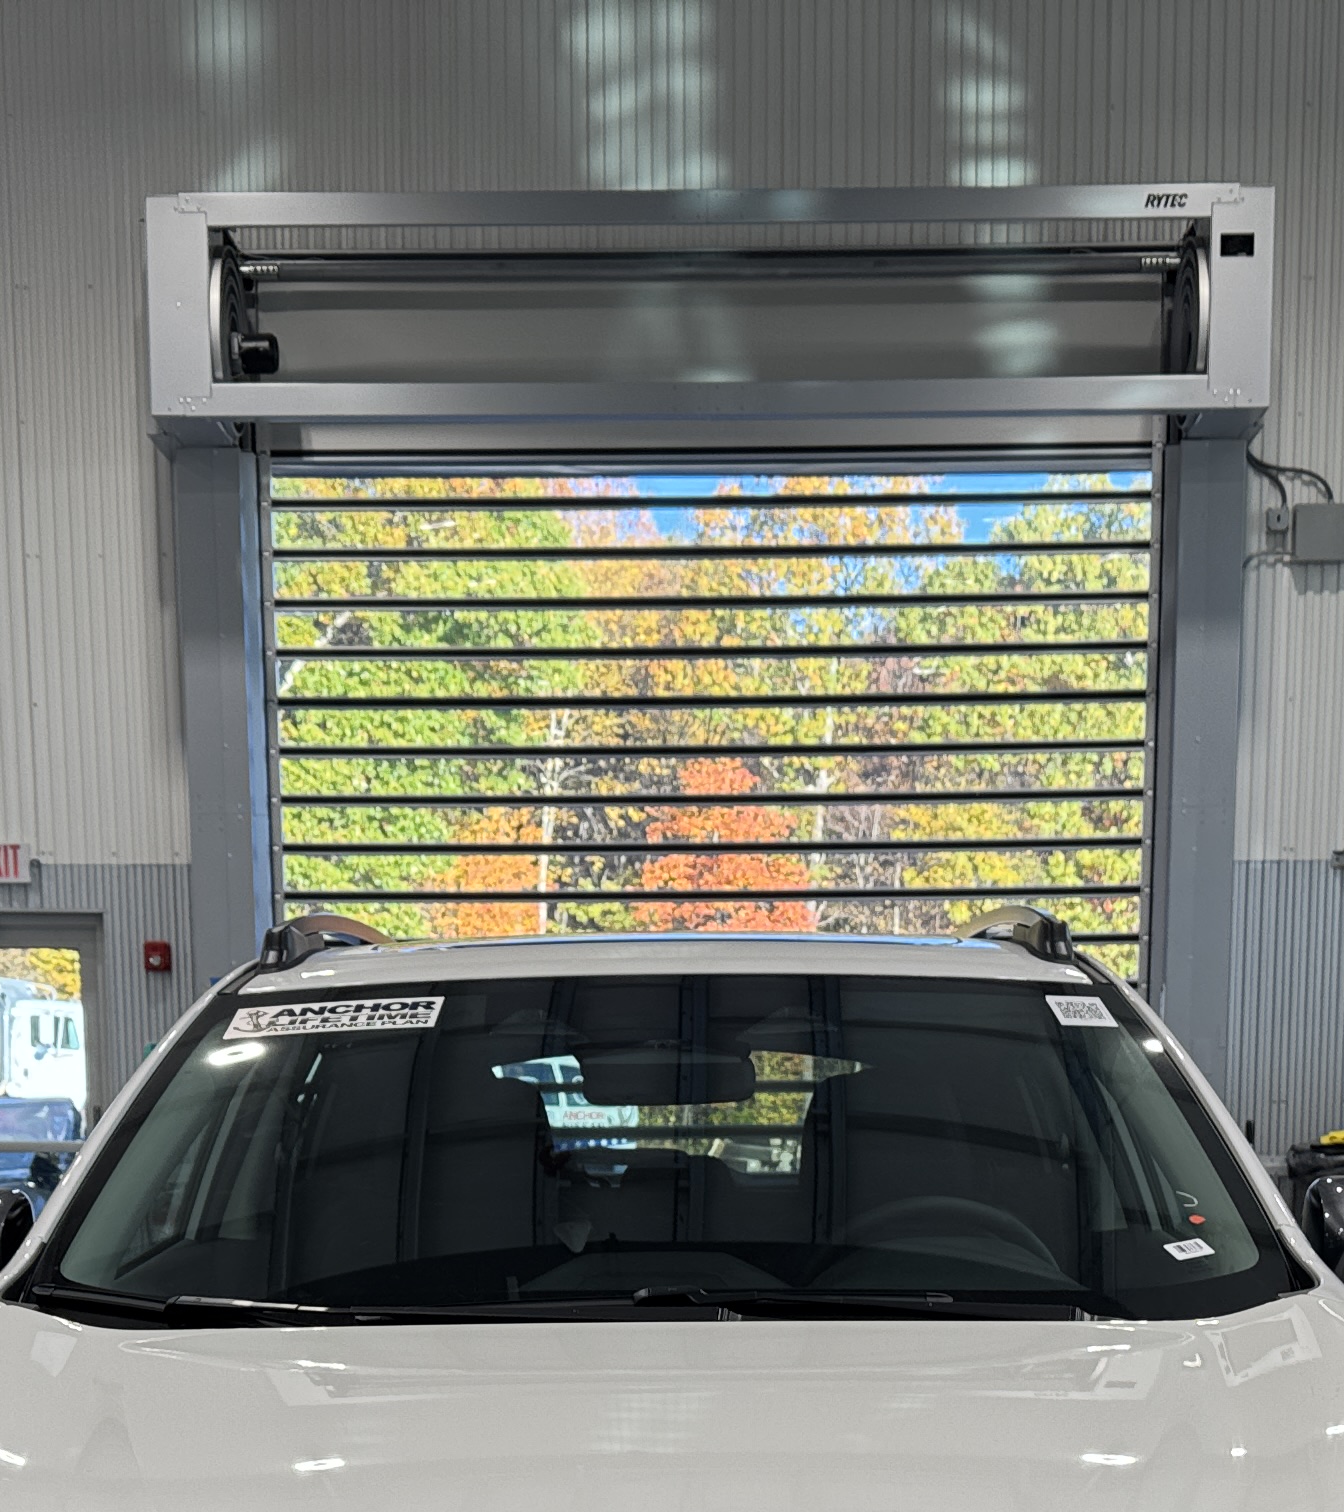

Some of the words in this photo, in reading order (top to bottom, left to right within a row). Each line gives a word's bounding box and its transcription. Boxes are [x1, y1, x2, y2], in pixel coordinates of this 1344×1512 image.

[1144, 192, 1188, 208] RYTEC
[265, 1009, 433, 1027] LIFETIME
[270, 1000, 436, 1019] ANCHOR
